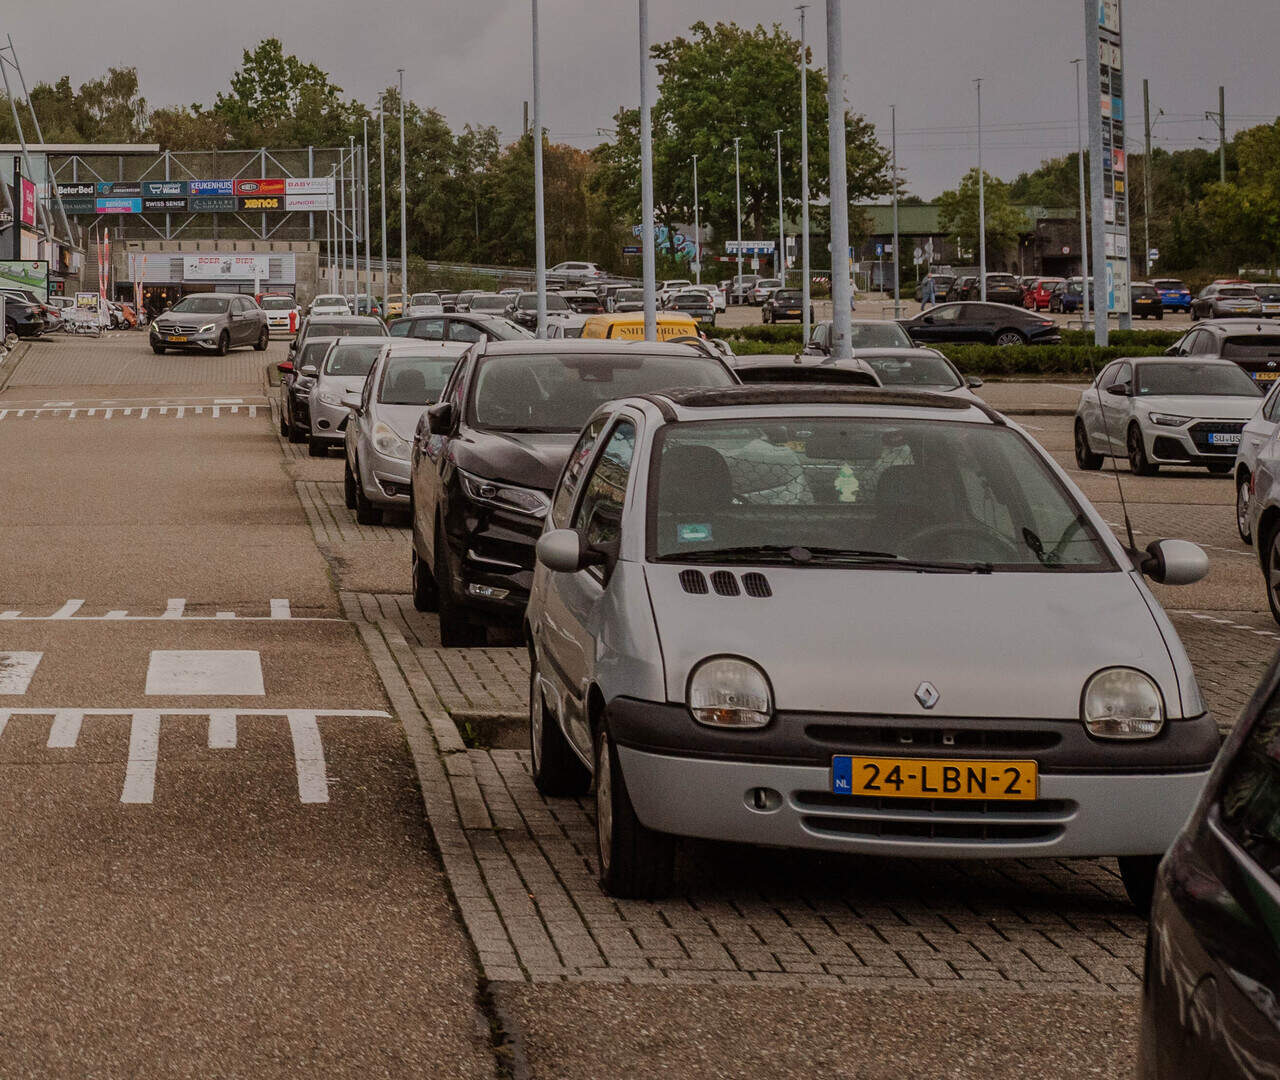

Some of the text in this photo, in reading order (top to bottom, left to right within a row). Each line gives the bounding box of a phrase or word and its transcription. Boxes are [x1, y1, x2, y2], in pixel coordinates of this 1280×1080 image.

[191, 181, 233, 190] KEUKENHUIS
[835, 763, 1022, 795] NL 24-LBN-2
